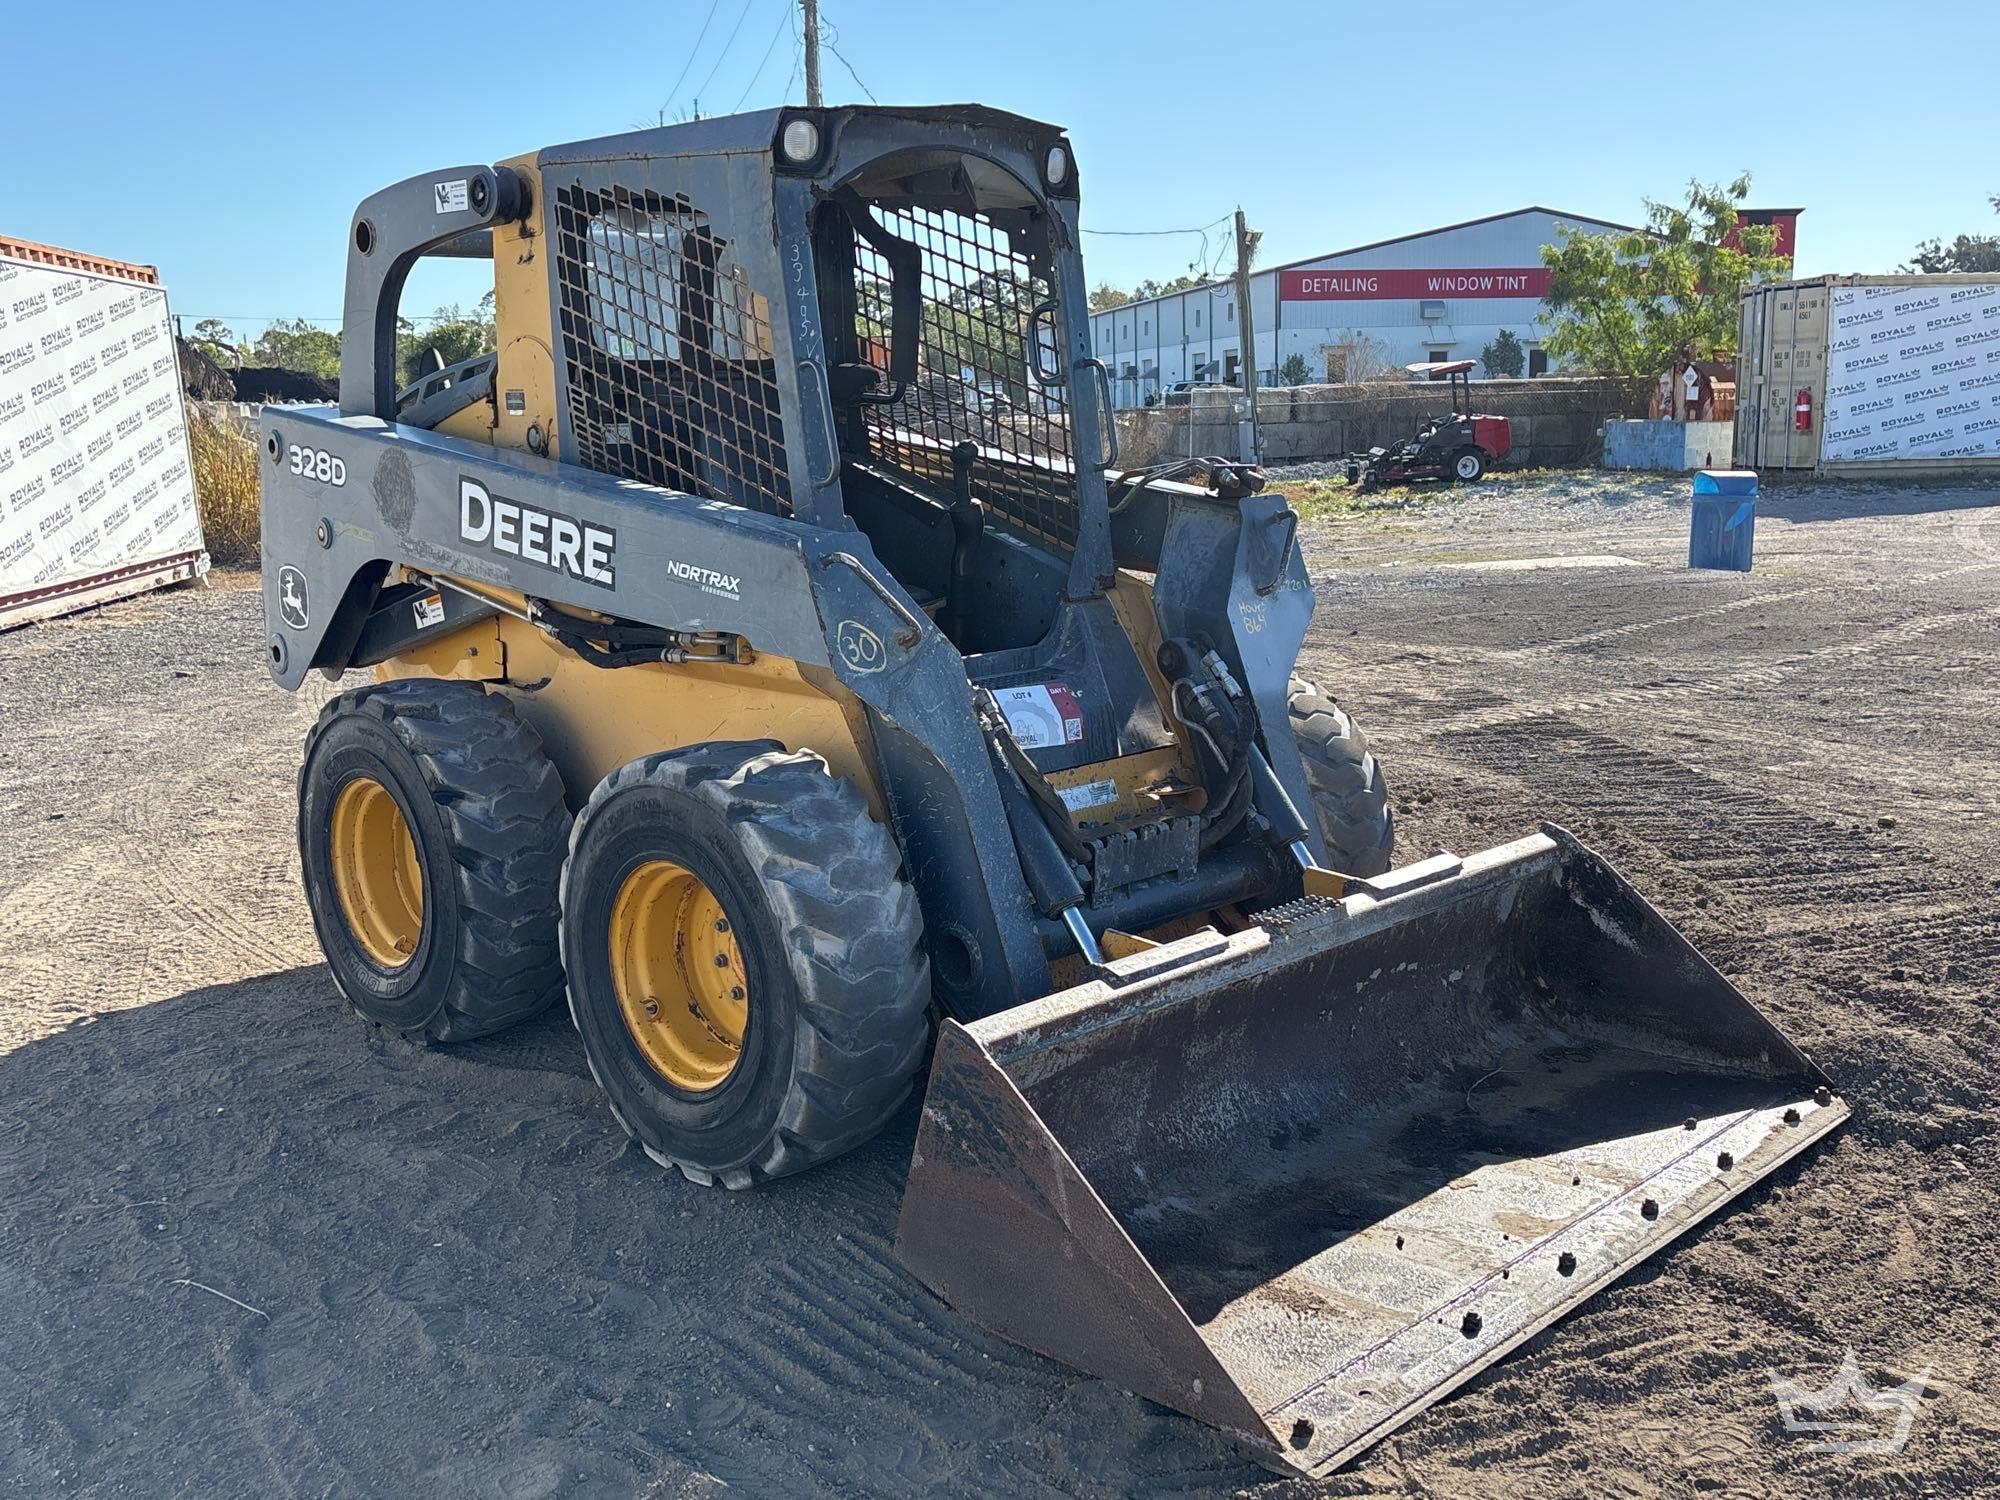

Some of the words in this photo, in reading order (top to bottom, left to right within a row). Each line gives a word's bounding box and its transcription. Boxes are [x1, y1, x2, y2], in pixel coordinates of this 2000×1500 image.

[52, 281, 75, 298] ROYAL
[1302, 277, 1378, 293] DETAILING
[1427, 276, 1493, 292] WINDOW
[1496, 275, 1529, 290] TINT
[1950, 287, 1986, 299] ROYAL
[12, 296, 39, 314] ROYAL
[109, 300, 130, 315] ROYAL
[1894, 300, 1930, 312] ROYAL
[76, 313, 98, 330] ROYAL
[1838, 312, 1874, 325] ROYAL
[1926, 315, 1962, 327] ROYAL
[41, 329, 66, 347] ROYAL
[132, 327, 152, 344] ROYAL
[1870, 328, 1906, 340] ROYAL
[1955, 331, 1991, 344] ROYAL
[101, 343, 121, 360] ROYAL
[1899, 344, 1935, 356] ROYAL
[70, 359, 91, 378] ROYAL
[1845, 356, 1879, 368] ROYAL
[1931, 359, 1966, 372] ROYAL
[122, 370, 143, 388] ROYAL
[1876, 371, 1910, 384] ROYAL
[1959, 375, 1994, 388] ROYAL
[31, 377, 58, 398] ROYAL
[1904, 388, 1940, 400] ROYAL
[92, 389, 113, 407] ROYAL
[146, 396, 166, 414] ROYAL
[1850, 399, 1885, 412] ROYAL
[59, 407, 83, 428] ROYAL
[1936, 403, 1971, 415] ROYAL
[116, 414, 137, 433] ROYAL
[1881, 415, 1916, 427] ROYAL
[1964, 418, 1999, 431] ROYAL
[19, 429, 46, 451] ROYAL
[87, 434, 107, 454] ROYAL
[1909, 431, 1944, 444] ROYAL
[138, 441, 158, 459] ROYAL
[1853, 443, 1888, 455] ROYAL
[50, 456, 78, 478] ROYAL
[109, 461, 129, 481] ROYAL
[161, 464, 181, 482] ROYAL
[289, 444, 346, 487] 328D
[10, 481, 37, 505] ROYAL
[78, 483, 100, 506] ROYAL
[132, 485, 152, 504] ROYAL
[39, 508, 65, 532] ROYAL
[103, 507, 124, 530] ROYAL
[154, 508, 173, 528] ROYAL
[461, 480, 614, 585] DEERE
[70, 533, 94, 557] ROYAL
[667, 560, 741, 593] NORTRAX
[842, 633, 877, 663] 30
[1012, 692, 1027, 700] LOT
